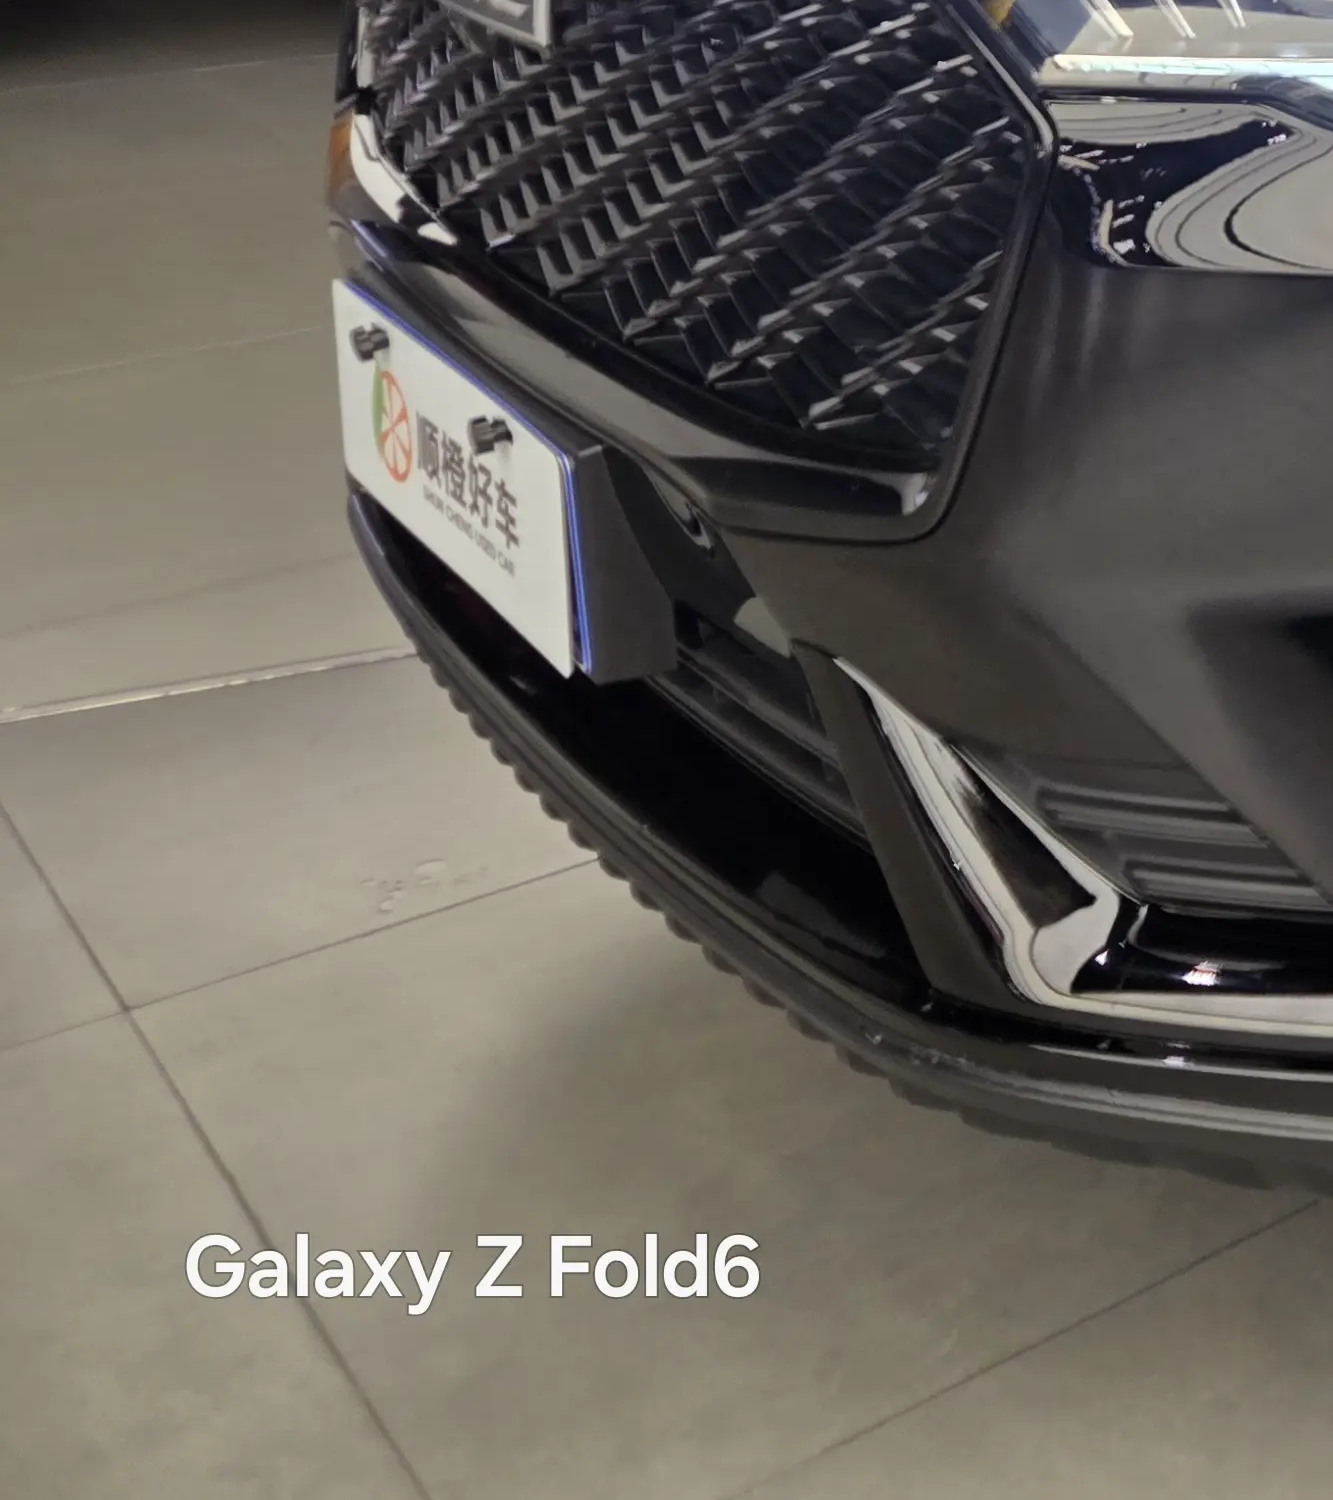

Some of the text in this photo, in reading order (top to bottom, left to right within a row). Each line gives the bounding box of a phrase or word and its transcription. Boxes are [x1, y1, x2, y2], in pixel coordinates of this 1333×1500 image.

[416, 410, 520, 550] 顺橙好车
[497, 551, 516, 578] CAR
